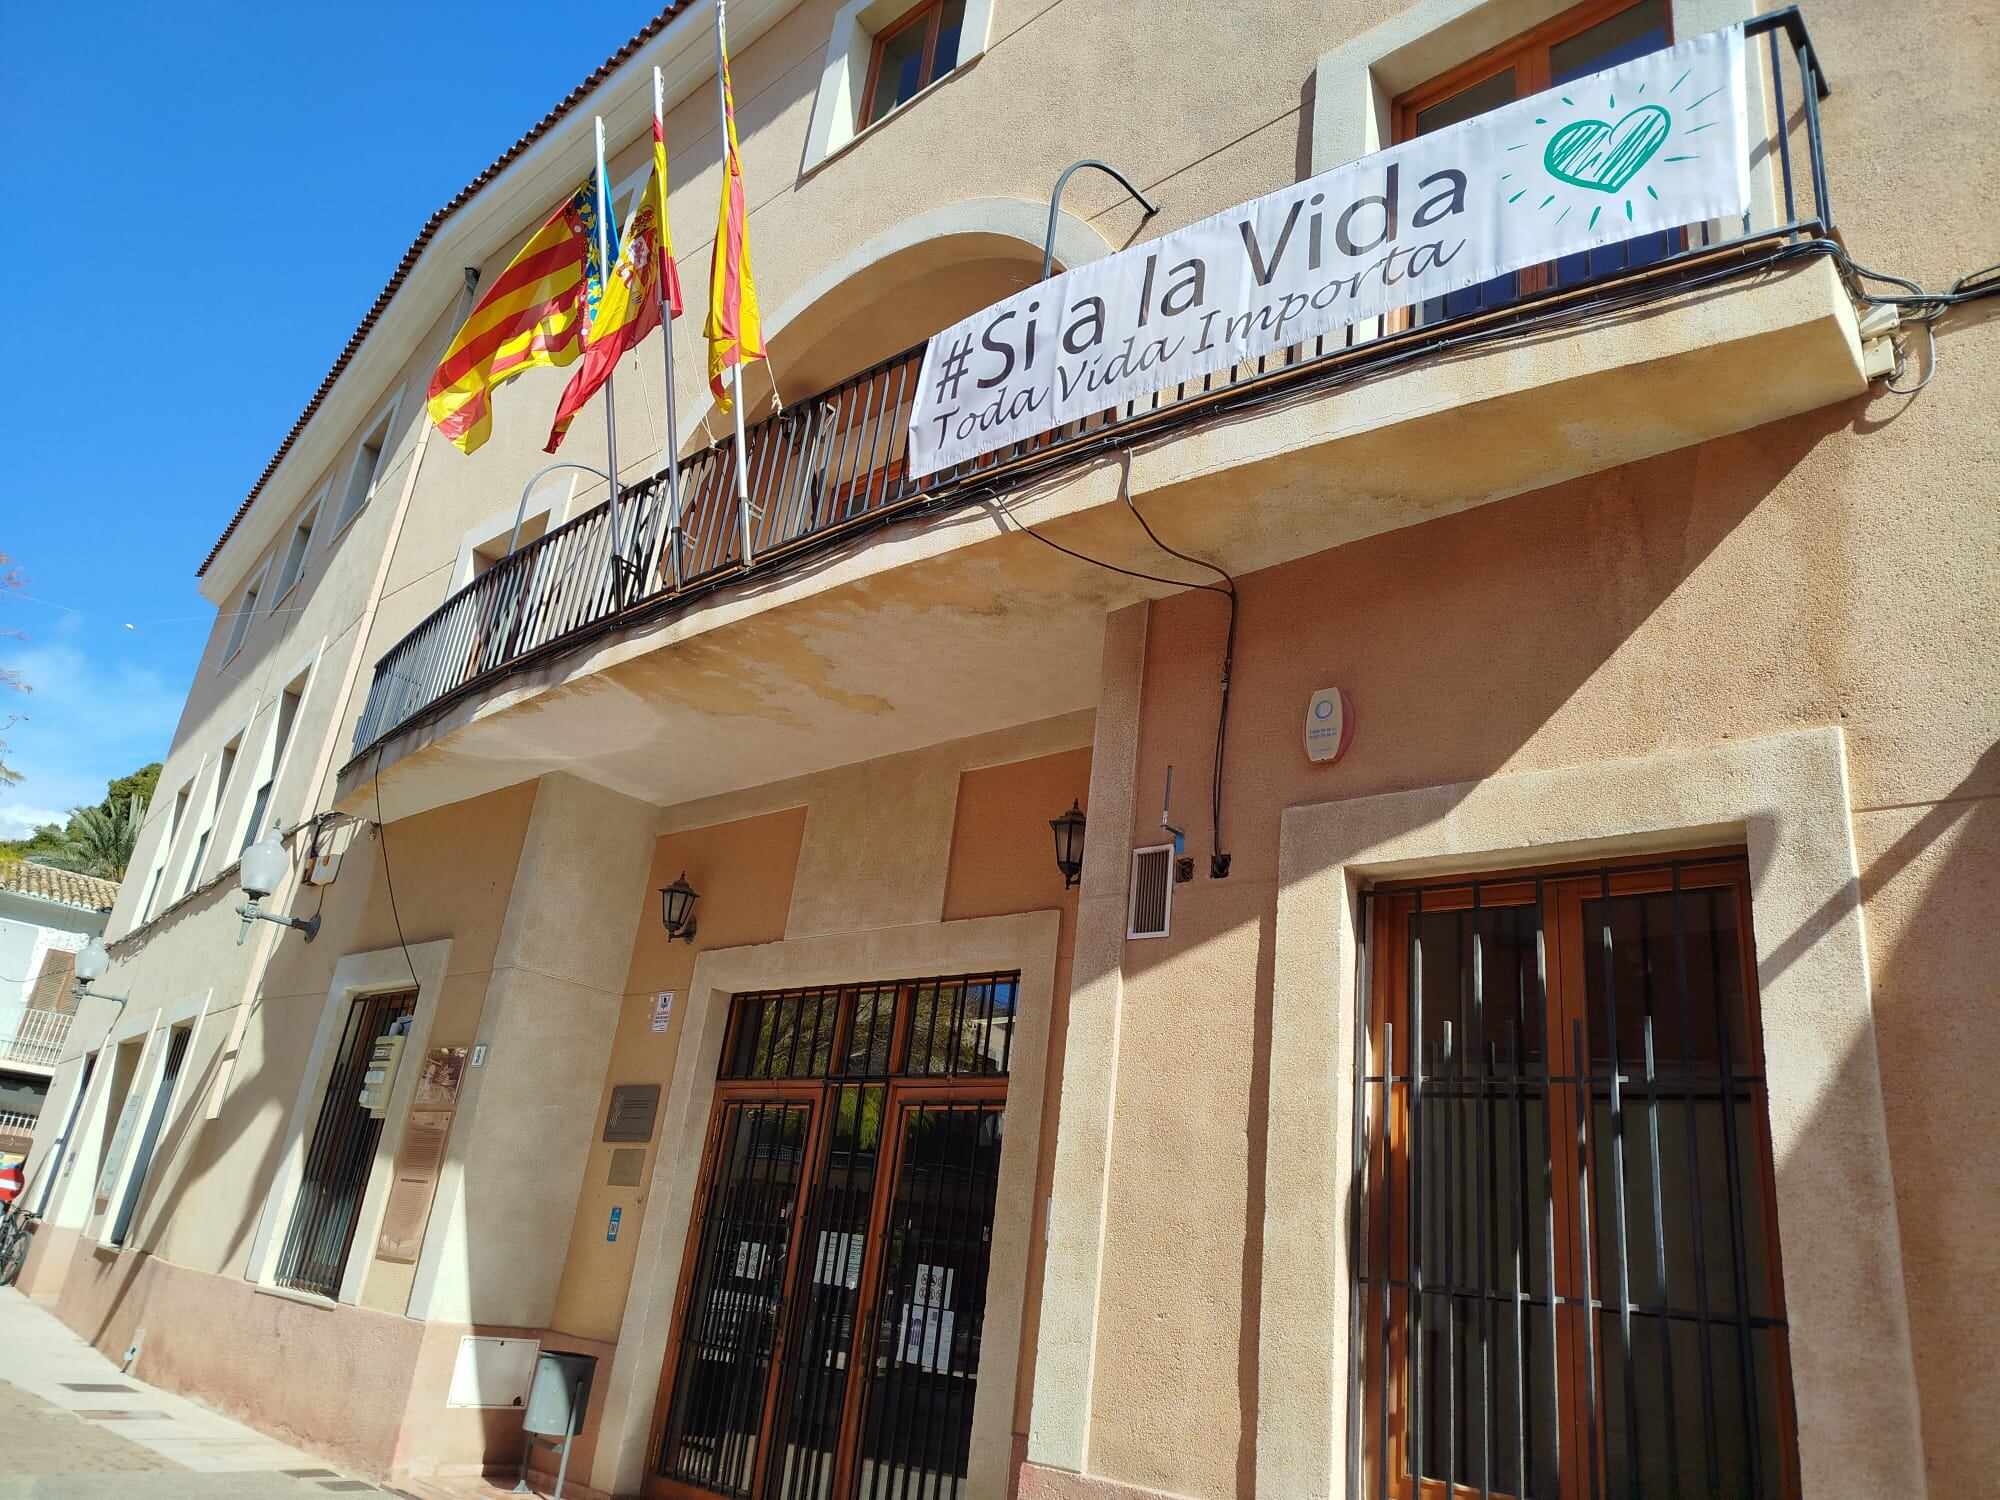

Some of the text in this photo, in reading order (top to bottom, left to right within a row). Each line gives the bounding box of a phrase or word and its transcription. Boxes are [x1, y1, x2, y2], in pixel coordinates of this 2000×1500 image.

[933, 238, 1466, 450] Toda Vida Importa
[936, 163, 1468, 405] #Si a la Vida
